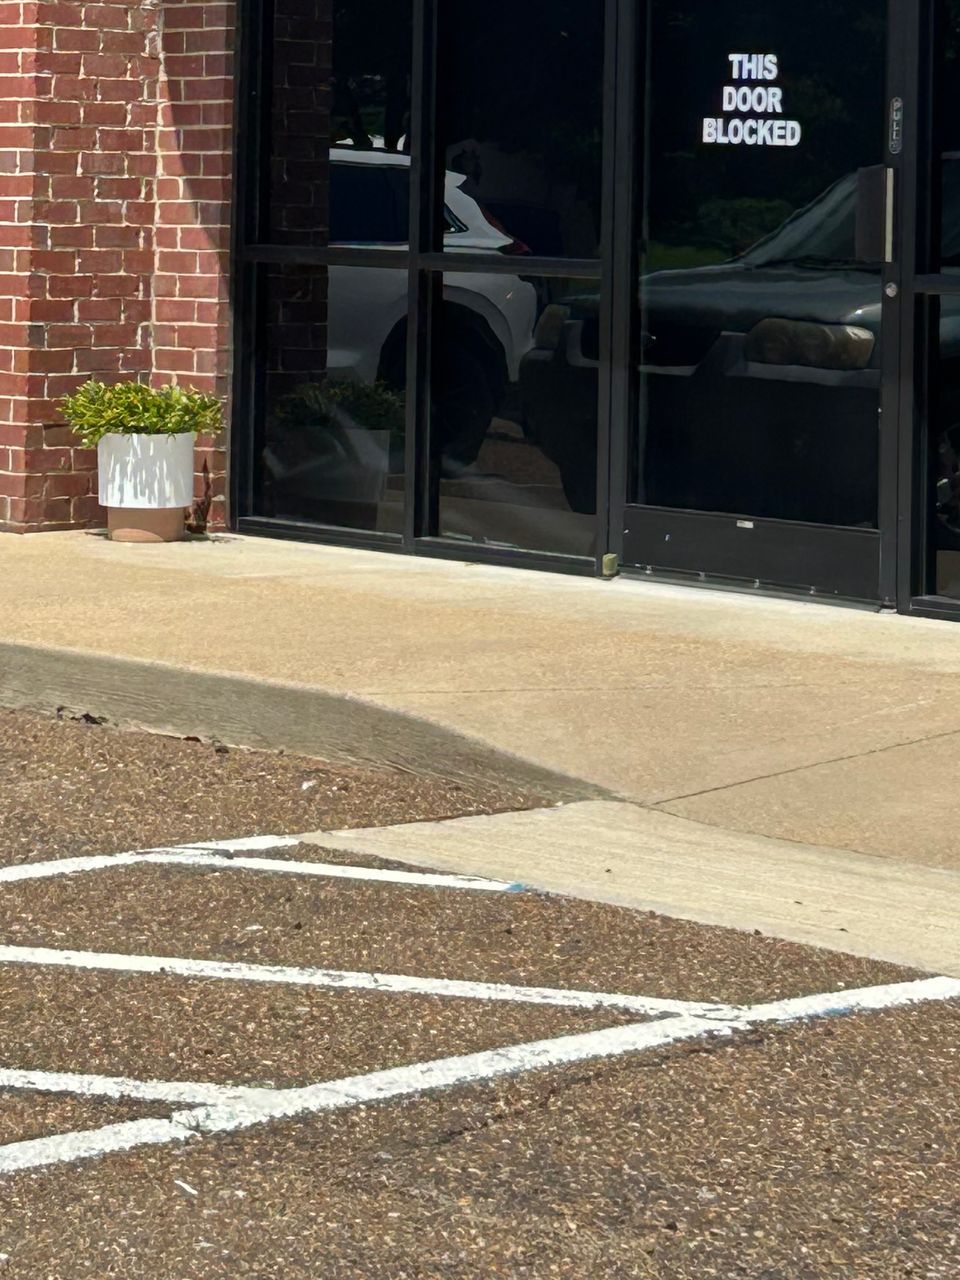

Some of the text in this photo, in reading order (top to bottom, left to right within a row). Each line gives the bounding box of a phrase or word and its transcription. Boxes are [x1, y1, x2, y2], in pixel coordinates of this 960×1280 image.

[727, 53, 779, 80] THIS
[722, 86, 783, 114] DOOR
[702, 117, 802, 147] BLOCKED
